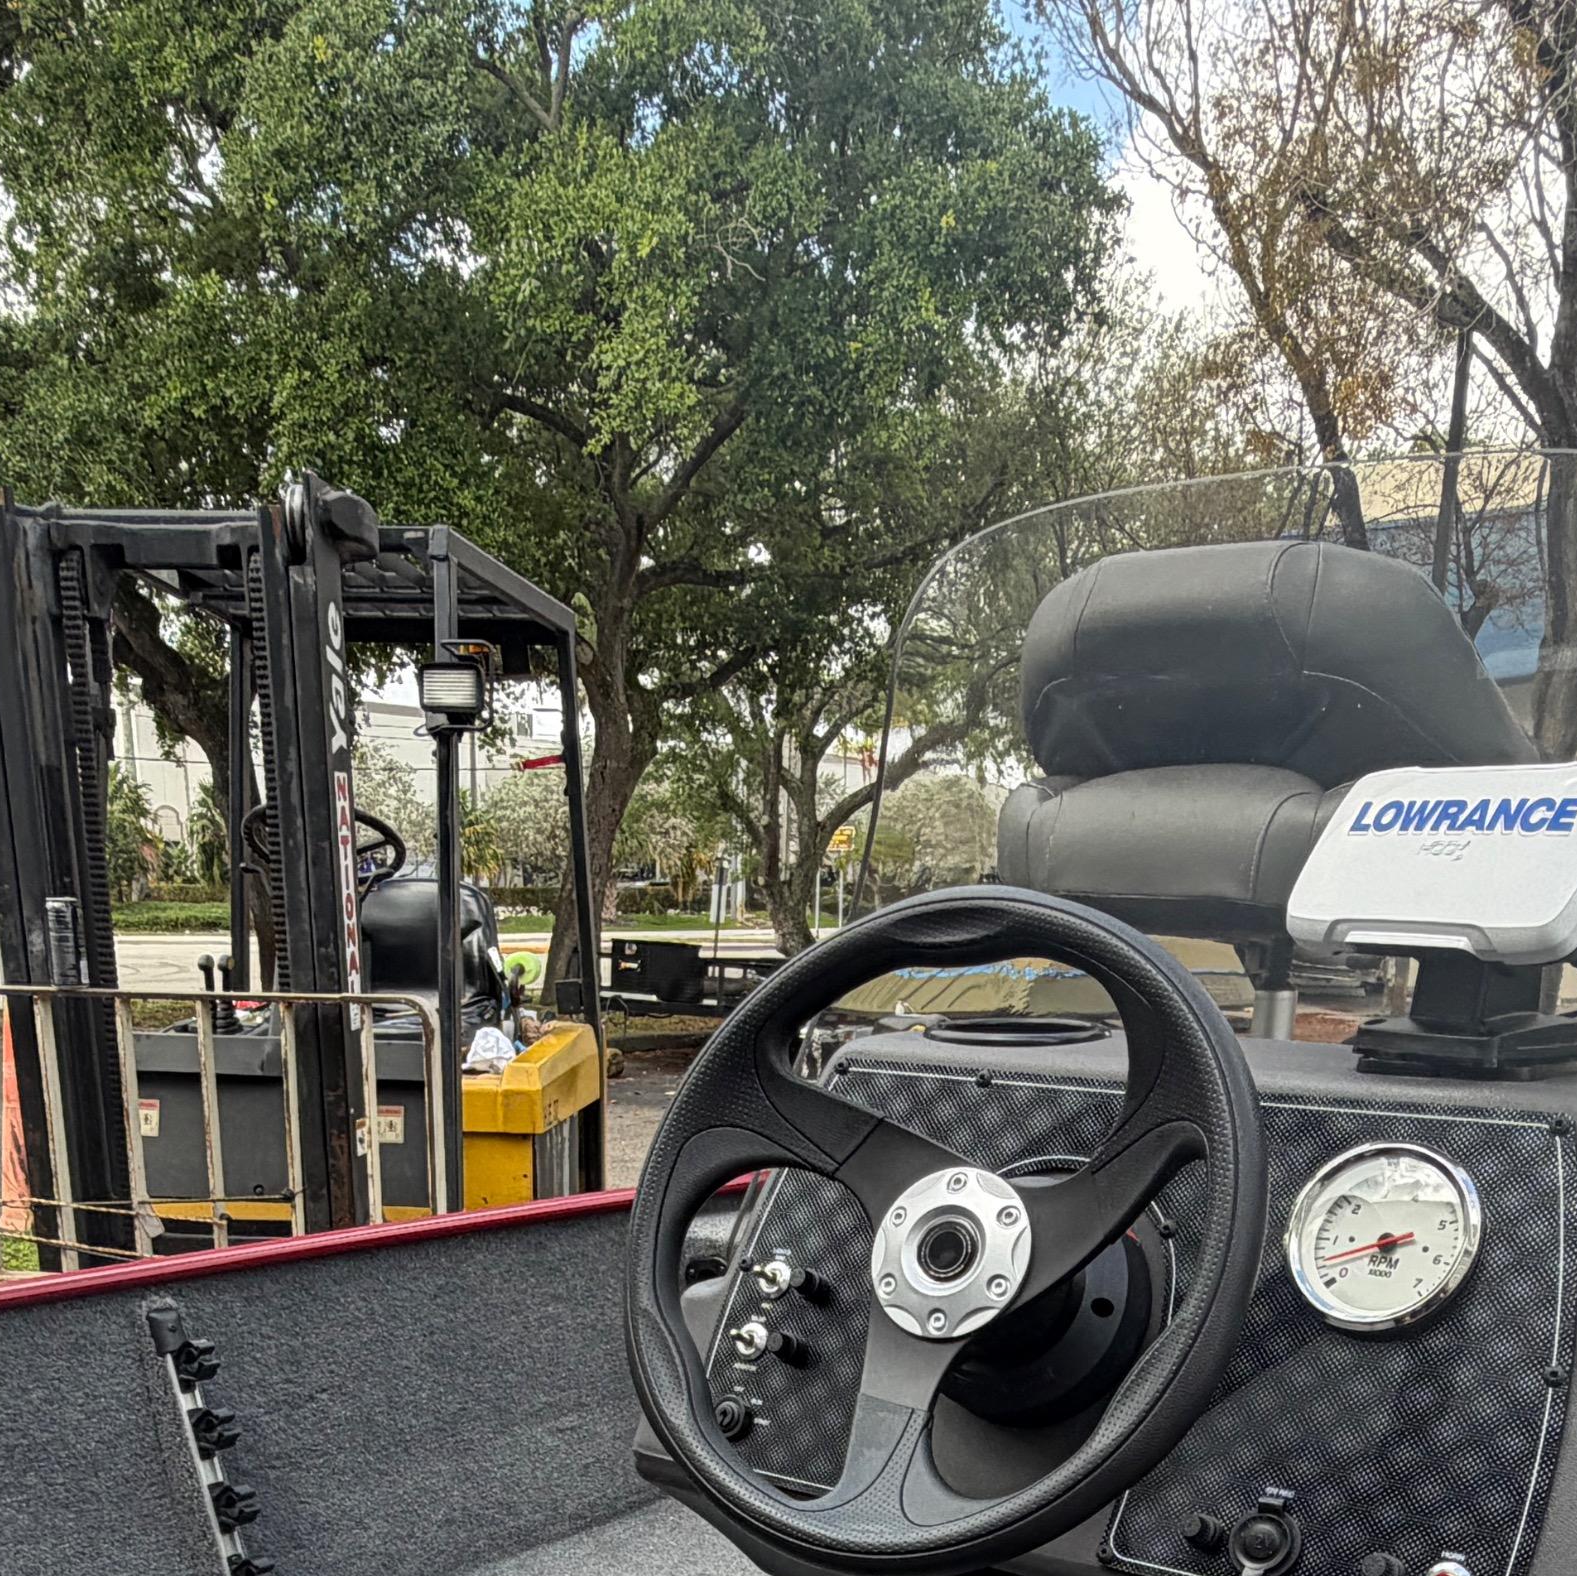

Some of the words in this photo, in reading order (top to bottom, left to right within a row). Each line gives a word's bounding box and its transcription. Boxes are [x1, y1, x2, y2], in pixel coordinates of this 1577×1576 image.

[326, 601, 348, 755] Yale
[1351, 1203, 1362, 1215] 2
[1438, 1219, 1448, 1231] 5
[1368, 1254, 1400, 1270] RPM
[1432, 1254, 1443, 1266] 6
[1339, 1267, 1349, 1278] 0
[1412, 1278, 1423, 1289] 7
